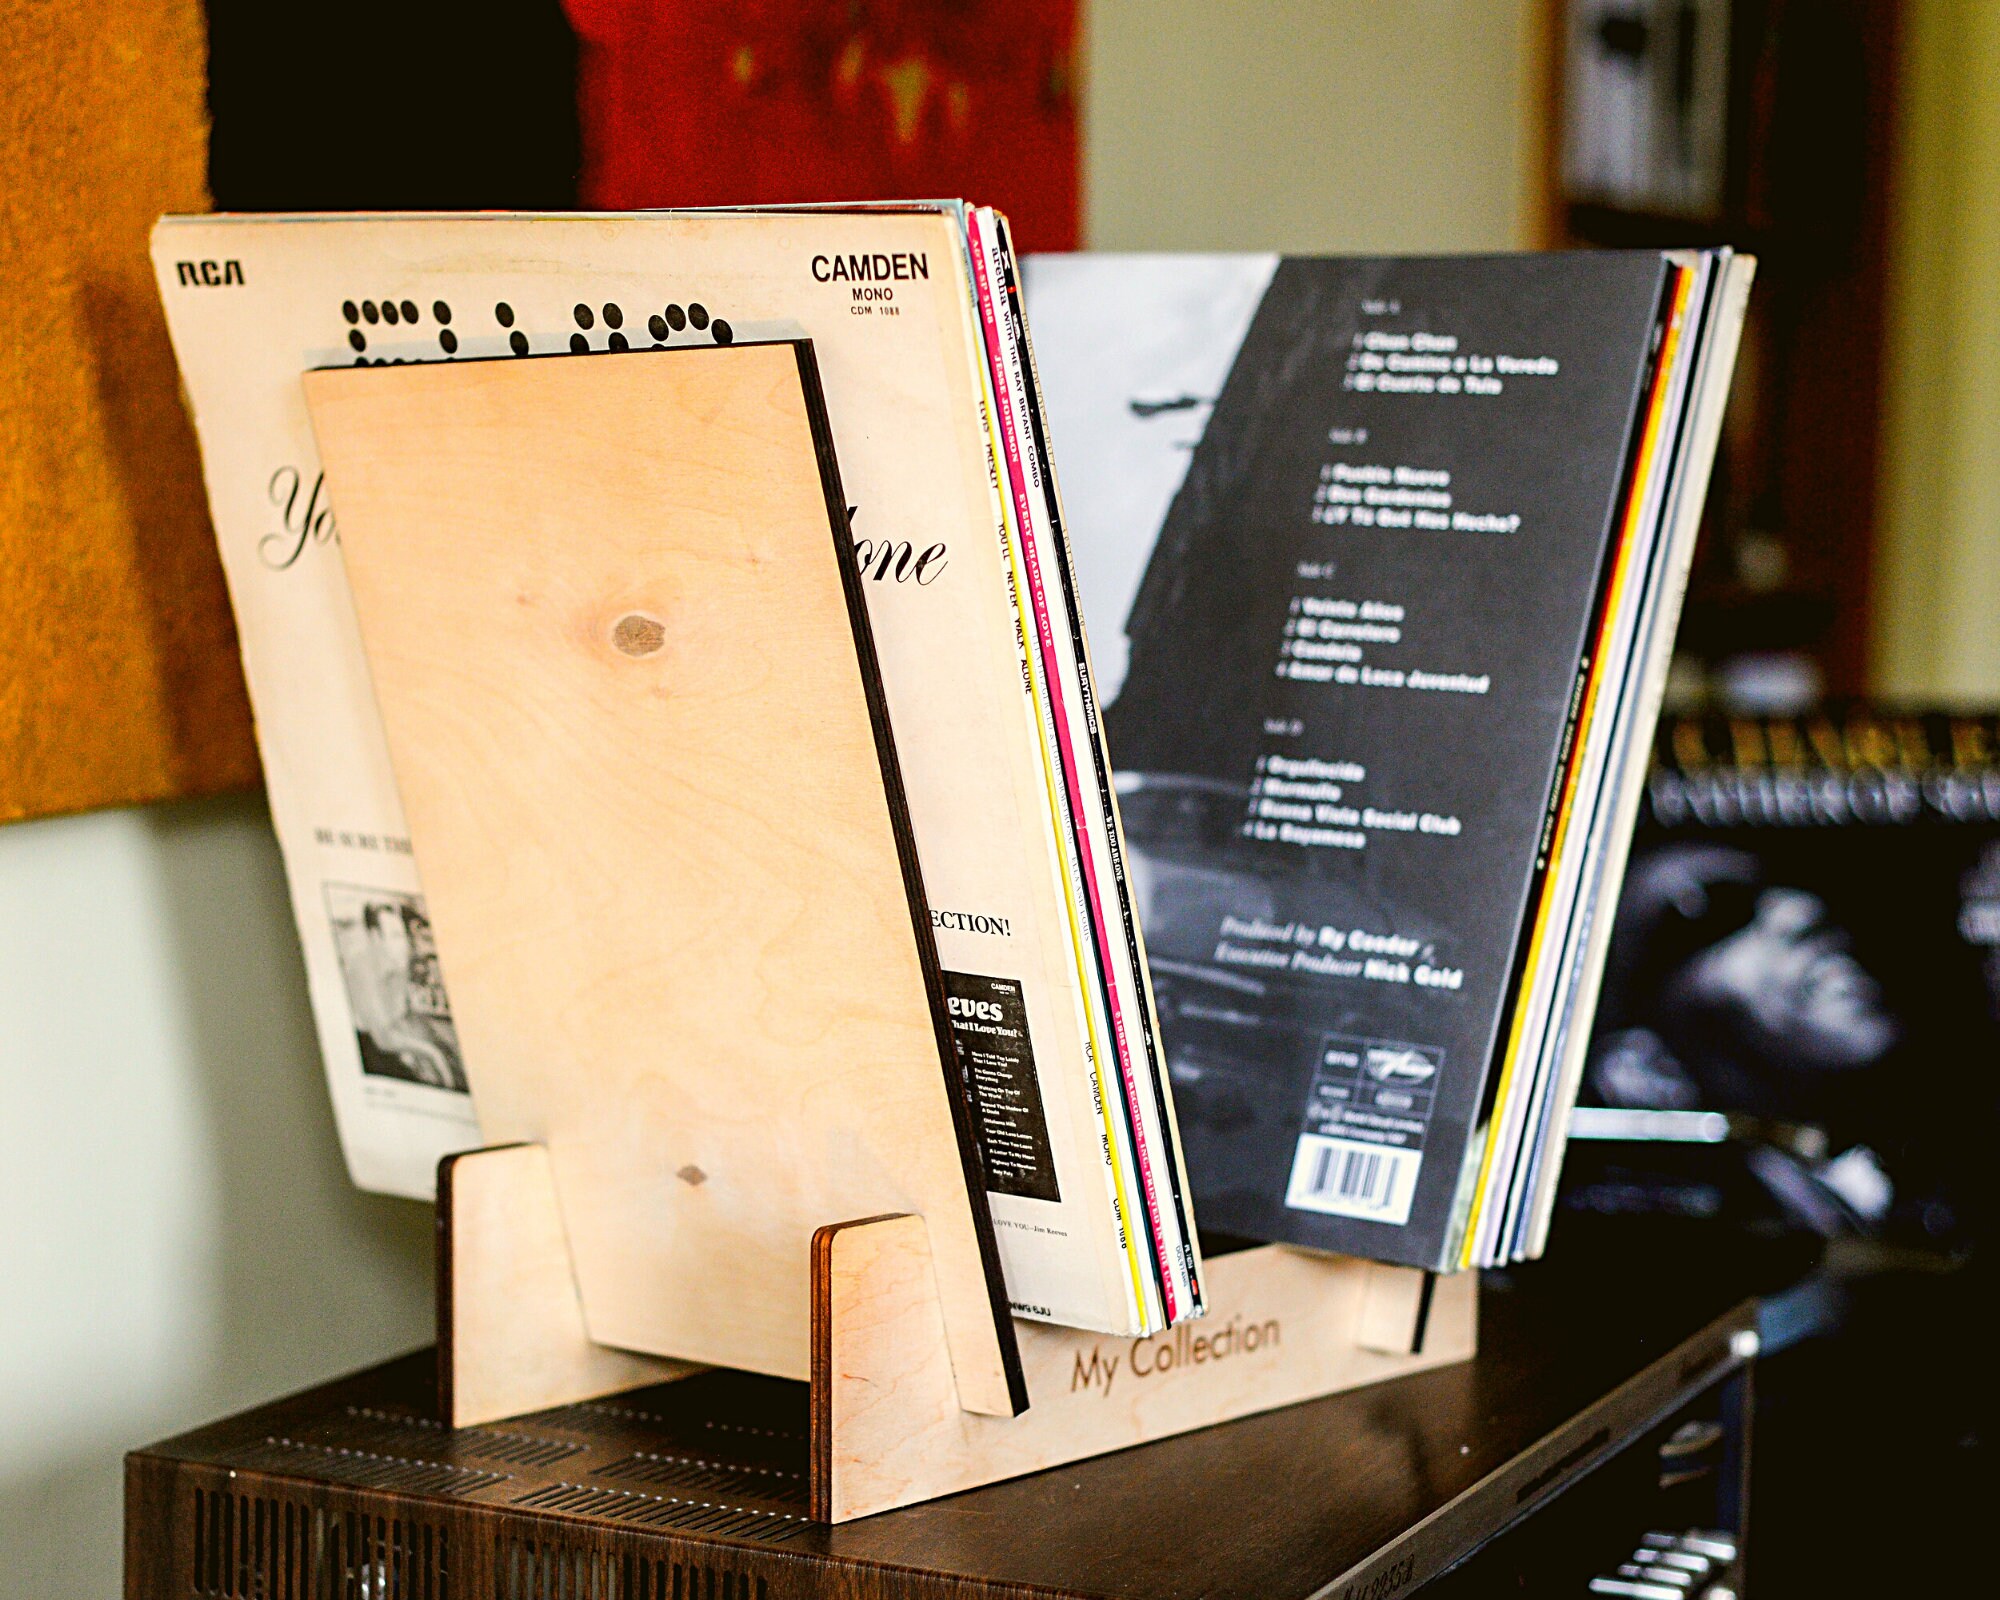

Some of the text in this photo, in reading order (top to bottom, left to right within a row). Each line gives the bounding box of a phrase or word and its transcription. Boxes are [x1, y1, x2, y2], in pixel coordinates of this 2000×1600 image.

[177, 260, 245, 287] RCA
[812, 253, 929, 282] CAMDEN
[978, 274, 987, 290] SP
[851, 306, 872, 315] CDM
[852, 288, 893, 301] MONO
[991, 246, 1009, 305] aretha
[1002, 311, 1013, 340] WITH
[1009, 345, 1017, 366] THE
[1013, 371, 1022, 391] RAY
[1018, 398, 1031, 440] BRYANT
[1027, 445, 1039, 487] COMBO
[994, 354, 1019, 462] JESSE JOHNSON
[257, 466, 341, 572] Yo
[847, 506, 948, 586] one
[1018, 493, 1052, 647] EVERY SHADE OF LOVE
[1077, 662, 1096, 734] EURYTHMICS
[1105, 815, 1123, 881] WE TOO ARE ONE
[929, 910, 1011, 936] ECTION!
[1084, 1041, 1094, 1062] RCA
[1089, 1071, 1103, 1114] CAMDEN
[1121, 1049, 1133, 1077] A&M
[1127, 1081, 1144, 1141] RECORDS,
[1139, 1143, 1150, 1168] INC.
[1144, 1170, 1160, 1224] PRINTED
[1155, 1226, 1163, 1239] IN
[1158, 1245, 1167, 1266] THE
[1163, 1271, 1174, 1303] U.S.A.
[1070, 1314, 1280, 1396] My Collection
